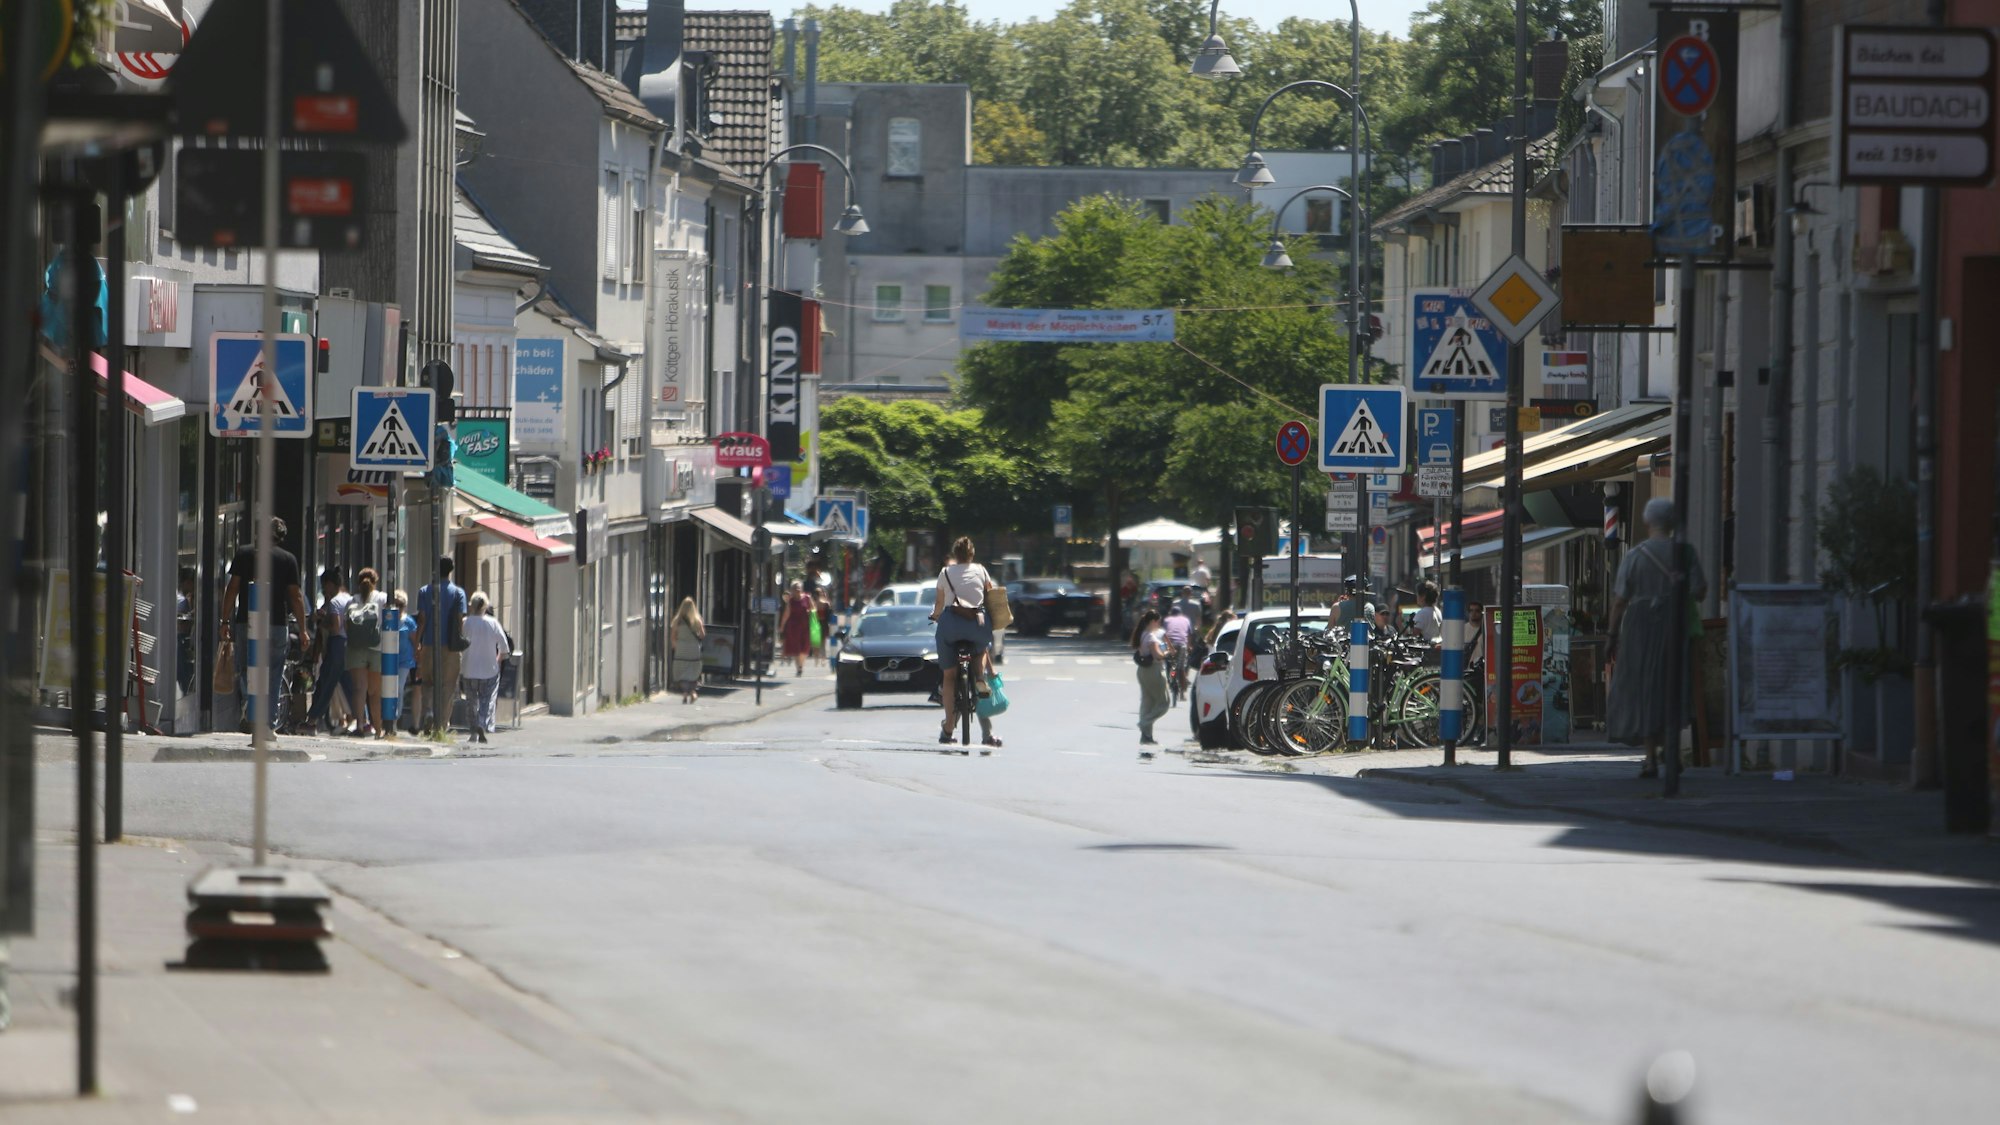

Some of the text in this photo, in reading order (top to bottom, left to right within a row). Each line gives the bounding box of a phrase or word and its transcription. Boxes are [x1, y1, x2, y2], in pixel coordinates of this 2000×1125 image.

[1855, 95, 1982, 119] BAUDACH
[1856, 144, 1885, 162] seit
[665, 268, 681, 383] Köttgen Hörakustik
[987, 320, 1137, 333] Markt der Möglichkeiten
[1142, 314, 1168, 326] 5.7.
[771, 327, 798, 425] KIND
[1424, 412, 1440, 436] P
[459, 432, 480, 446] vom
[466, 436, 499, 455] FASS
